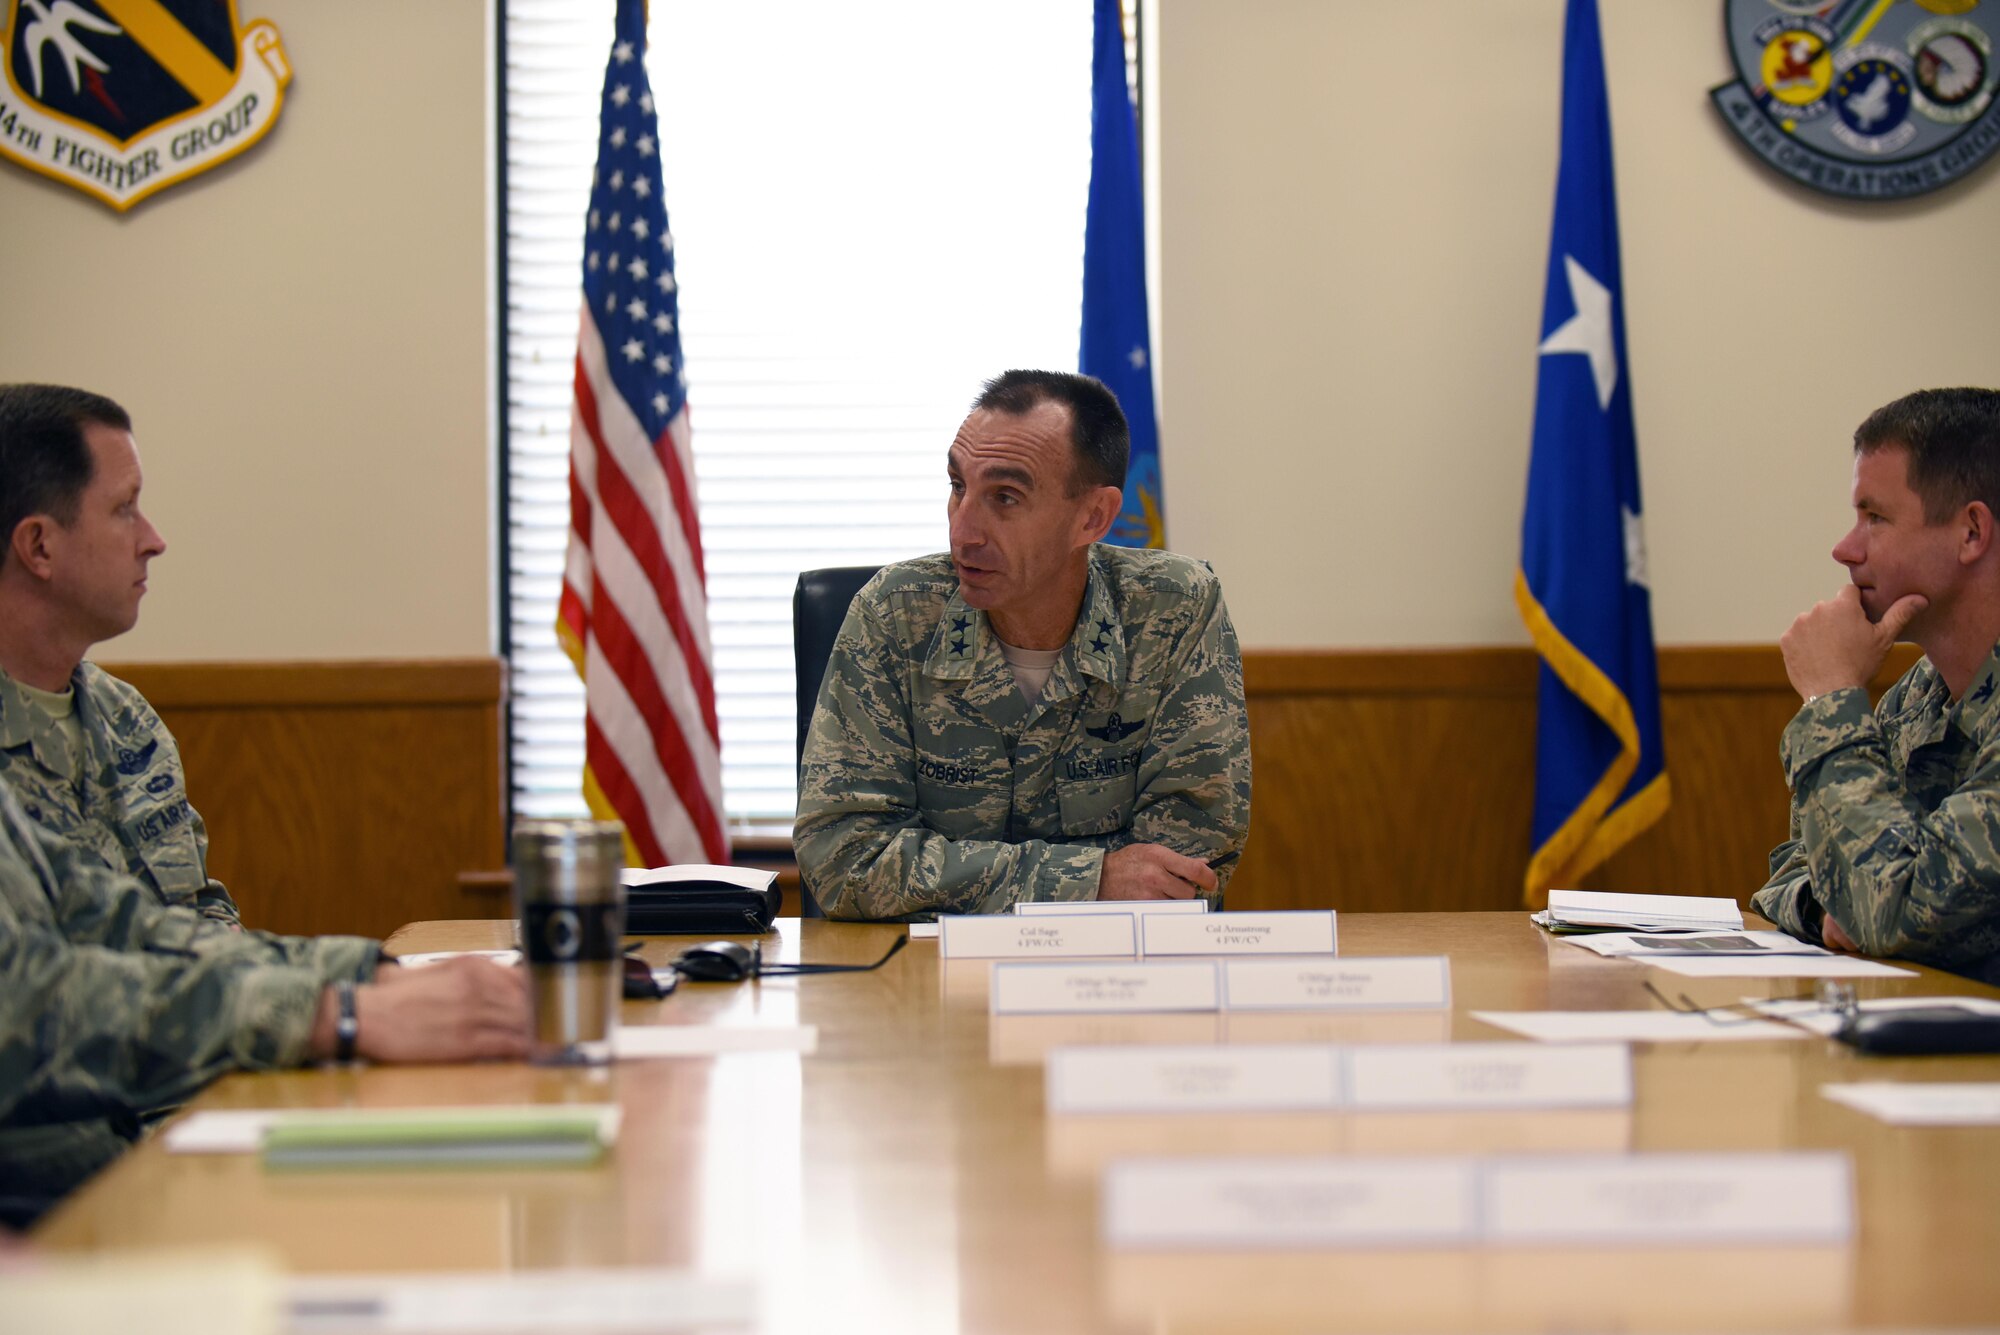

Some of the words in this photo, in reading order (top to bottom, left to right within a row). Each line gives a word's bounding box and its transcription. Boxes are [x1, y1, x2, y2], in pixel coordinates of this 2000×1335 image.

[52, 134, 161, 190] FIGHTER
[170, 93, 259, 161] GROUP
[1776, 143, 1940, 195] OPERATIONS
[918, 758, 979, 785] ZOBRIST
[1095, 756, 1120, 777] AIR
[158, 804, 184, 831] AIR
[1020, 927, 1036, 936] Col
[1205, 924, 1222, 933] Col
[1223, 924, 1271, 935] Armstrong
[1025, 938, 1064, 948] FW/CC
[1224, 936, 1262, 945] FW/CV
